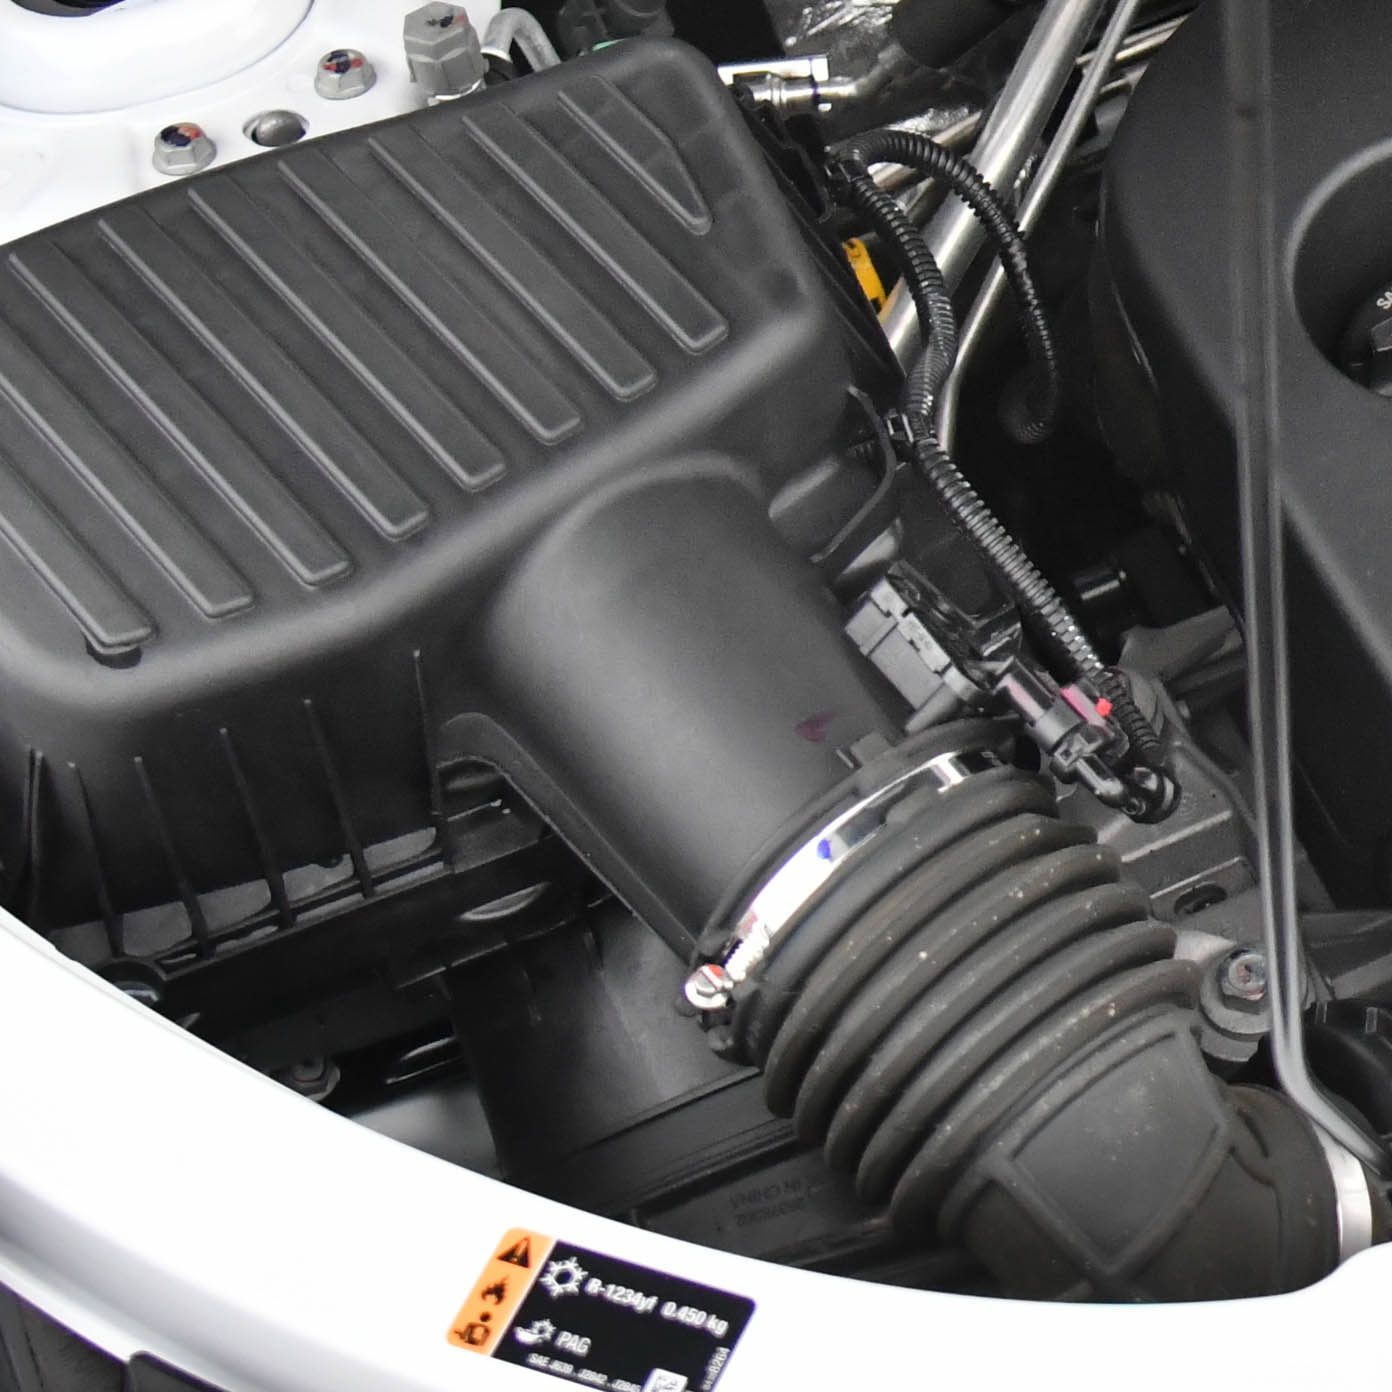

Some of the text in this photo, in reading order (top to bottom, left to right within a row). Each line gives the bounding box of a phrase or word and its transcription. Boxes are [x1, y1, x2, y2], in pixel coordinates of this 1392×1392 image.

[585, 1277, 730, 1339] R-1234yf 0.450 kg
[555, 1330, 592, 1357] PAG
